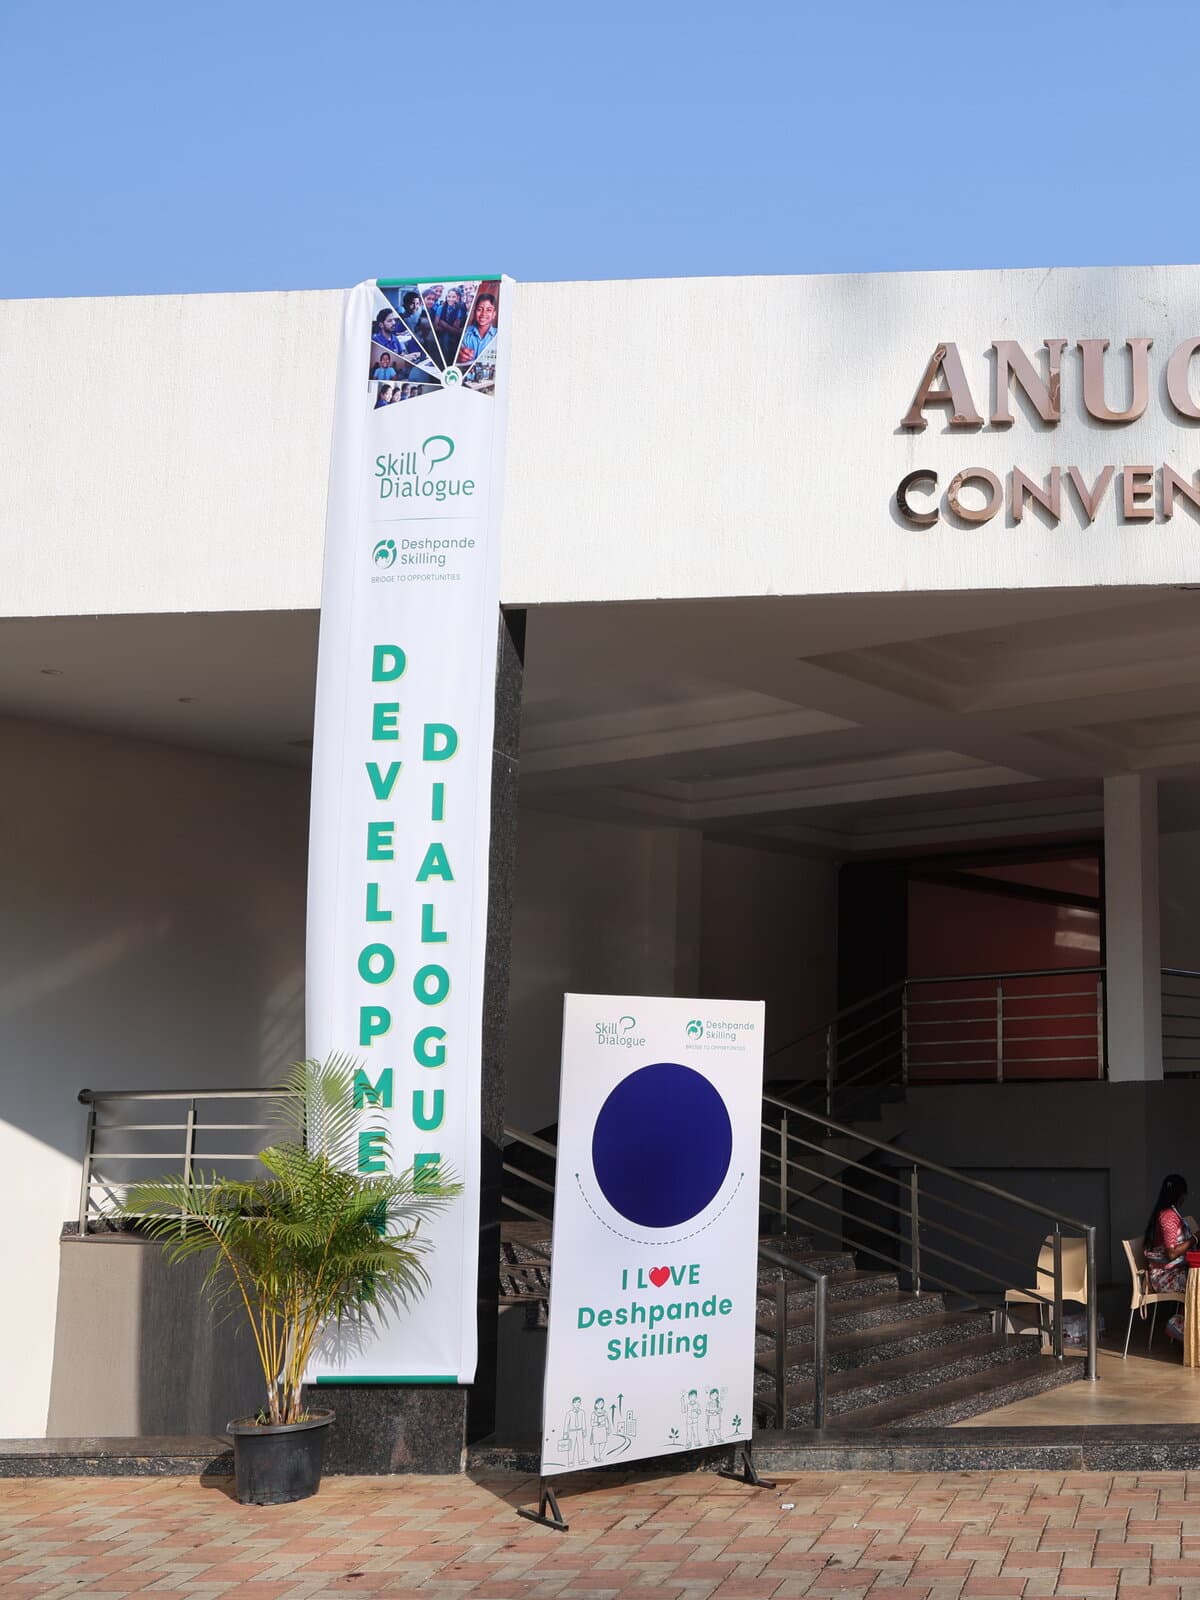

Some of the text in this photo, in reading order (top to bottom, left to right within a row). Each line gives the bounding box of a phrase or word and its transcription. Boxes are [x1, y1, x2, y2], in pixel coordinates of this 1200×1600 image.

[374, 452, 417, 477] Skill
[379, 475, 475, 501] Dialogue
[401, 537, 475, 554] Deshpande
[400, 553, 447, 567] Skilling
[413, 723, 459, 1195] DIALOGUE
[353, 644, 407, 1300] DEVELOPME
[595, 1022, 618, 1034] Skill
[706, 1020, 755, 1031] Deshpande
[706, 1030, 736, 1041] Skilling
[598, 1033, 646, 1049] Dialogue
[622, 1269, 628, 1290] I
[577, 1295, 733, 1330] Deshpande
[607, 1331, 708, 1360] Skilling
